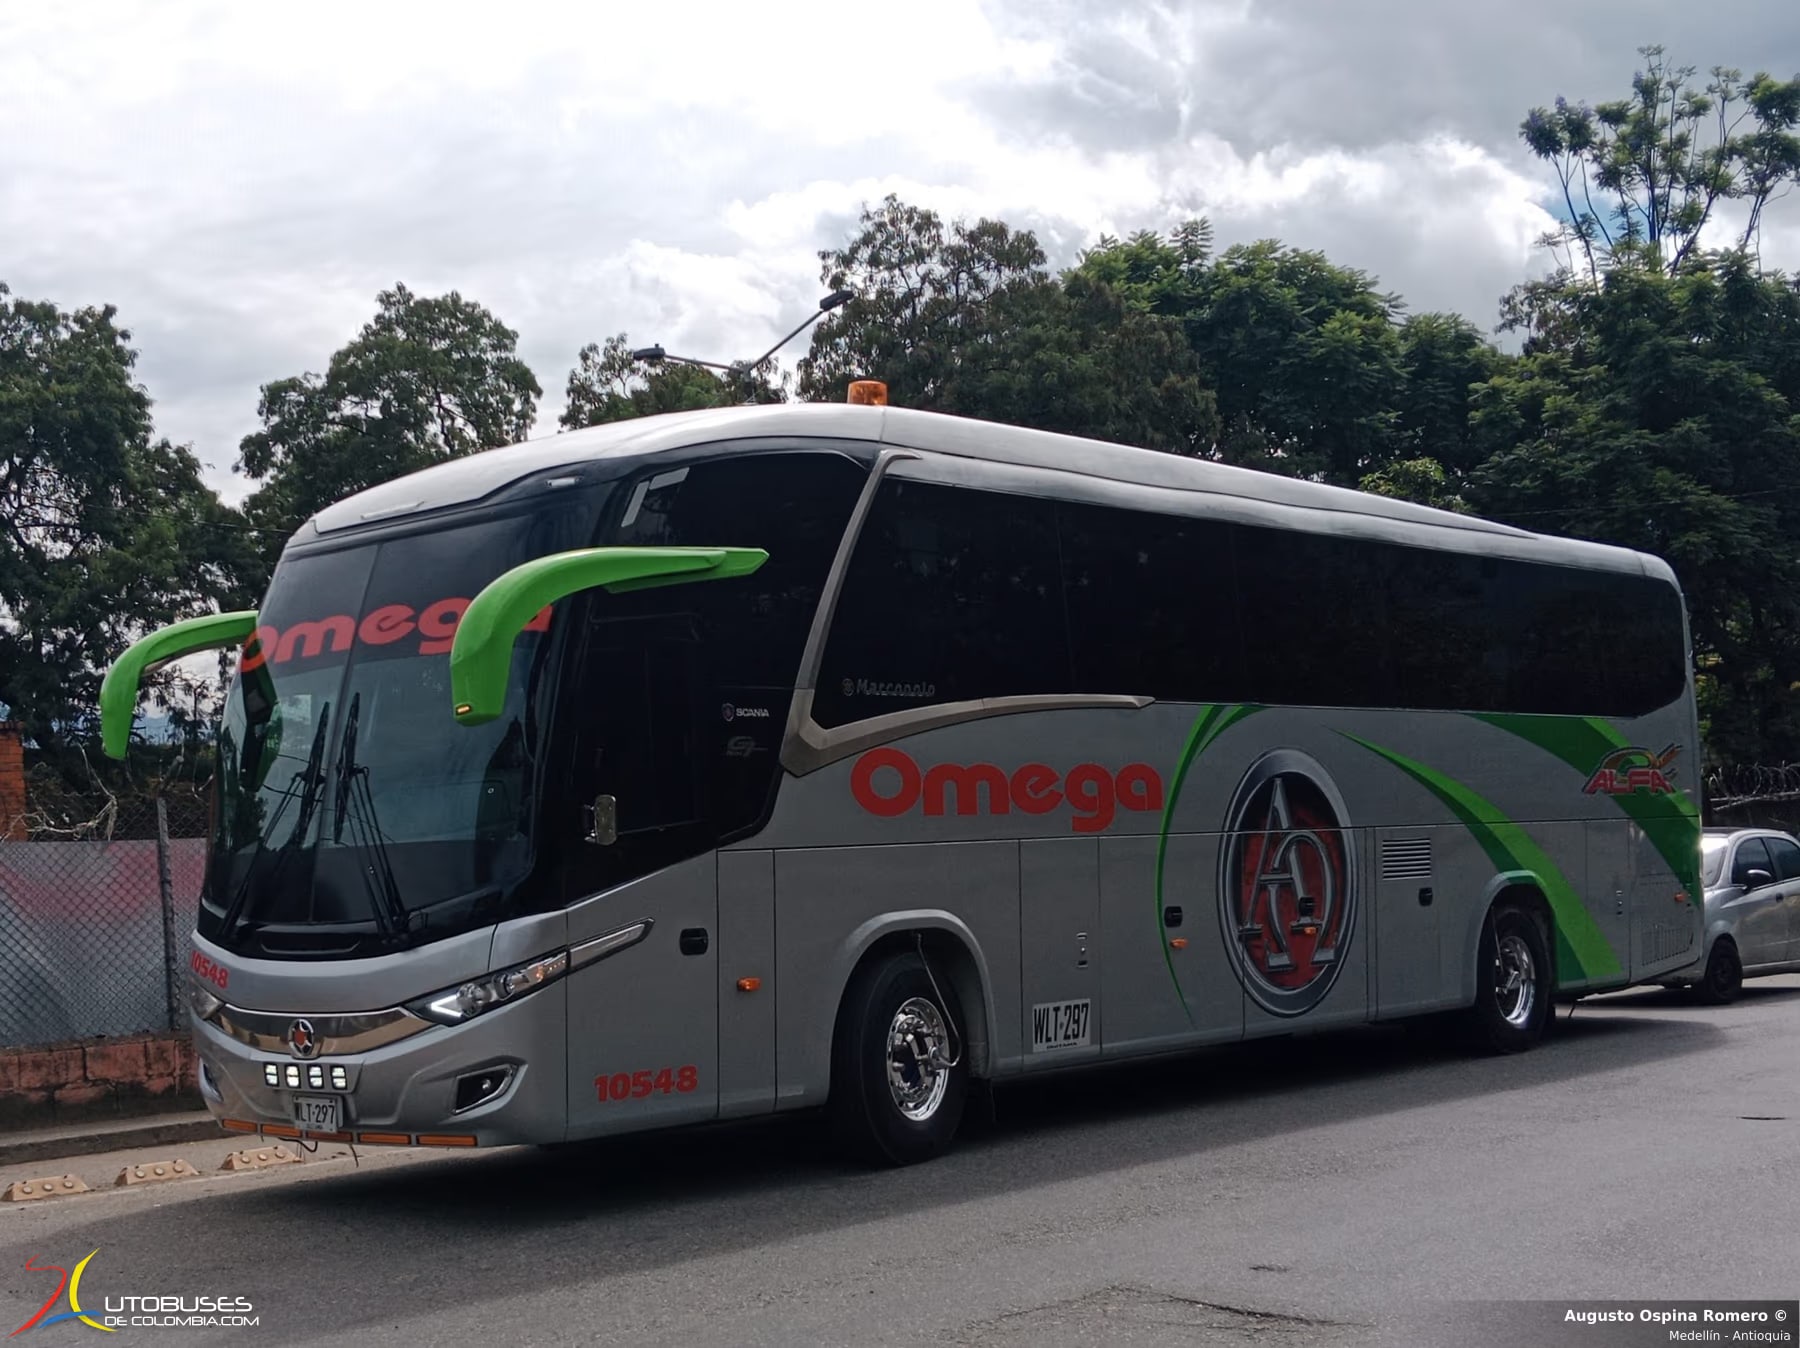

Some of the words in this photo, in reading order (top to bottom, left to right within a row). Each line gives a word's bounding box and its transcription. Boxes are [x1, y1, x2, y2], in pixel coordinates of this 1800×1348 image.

[736, 707, 770, 718] SCANIA
[851, 747, 1164, 833] Omega
[1583, 768, 1676, 795] ALFA
[190, 949, 230, 990] 10548
[594, 1064, 699, 1104] 10548
